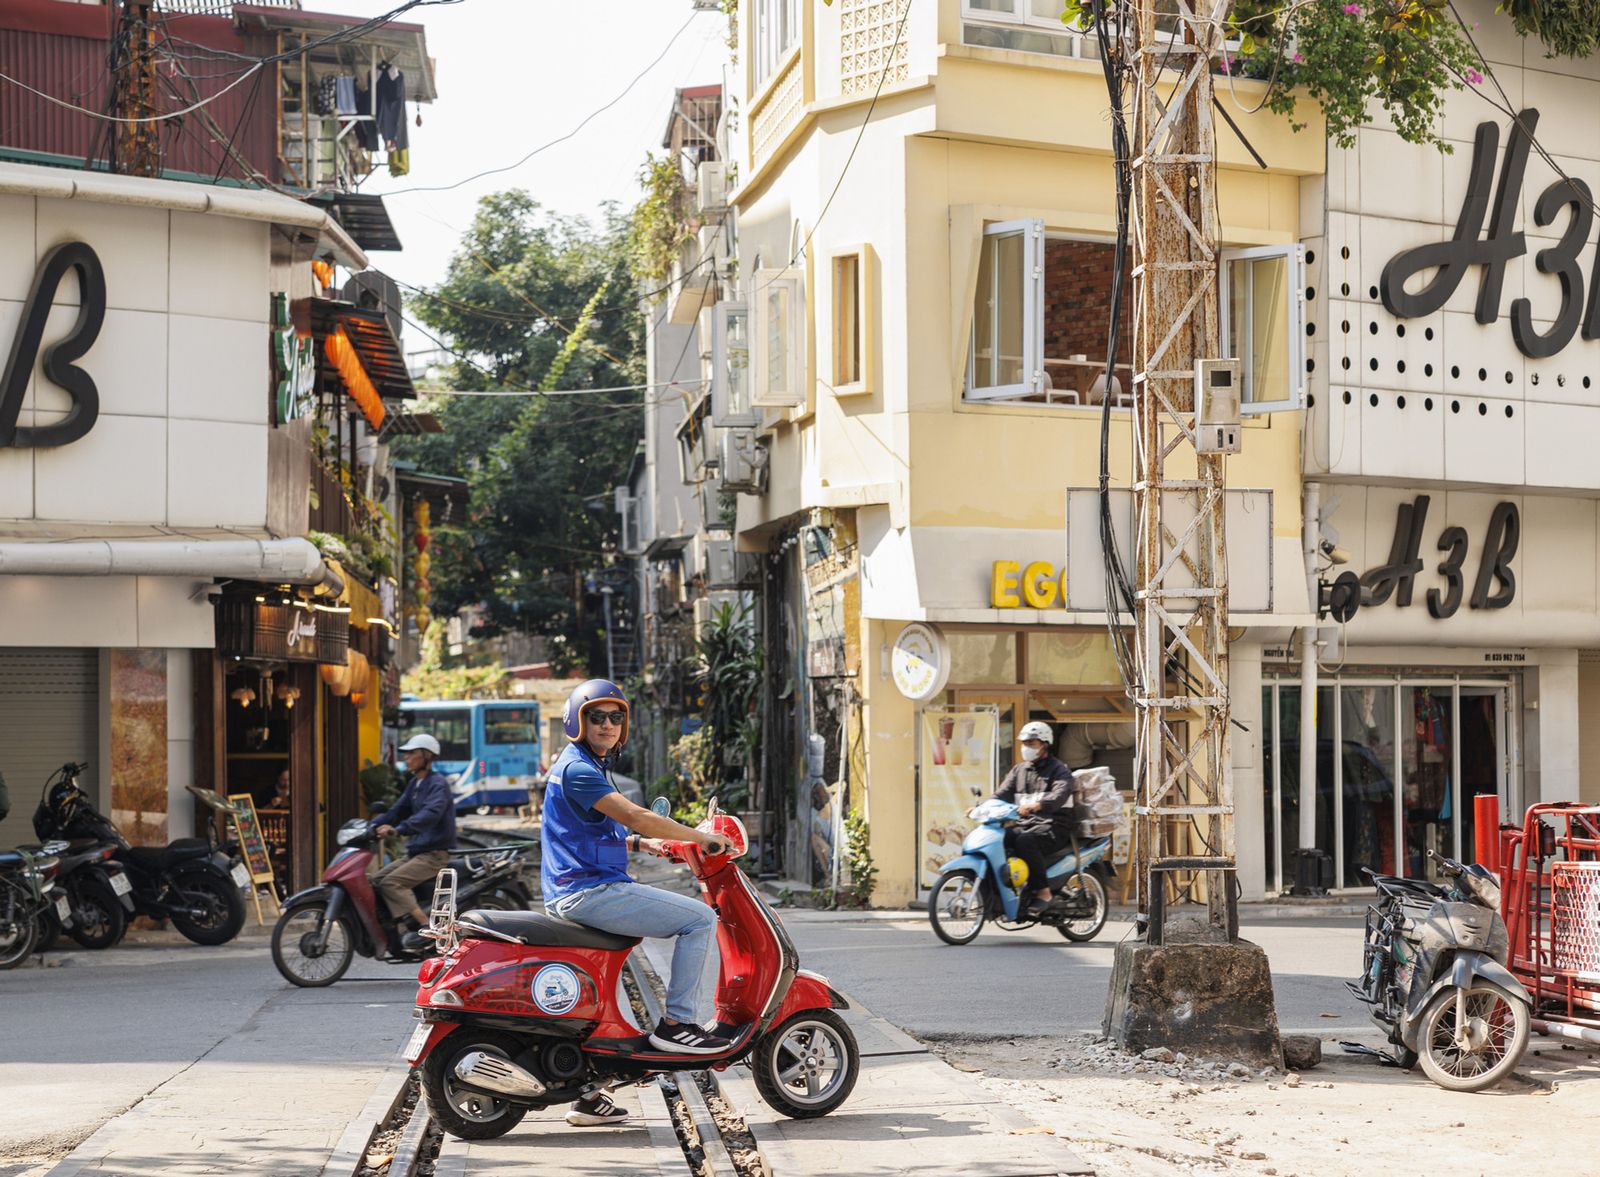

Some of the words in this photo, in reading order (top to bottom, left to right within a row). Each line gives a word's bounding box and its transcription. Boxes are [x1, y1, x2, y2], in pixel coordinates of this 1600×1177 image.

[1380, 107, 1600, 358] H3
[992, 560, 1066, 609] EG
[1359, 495, 1520, 619] H3B
